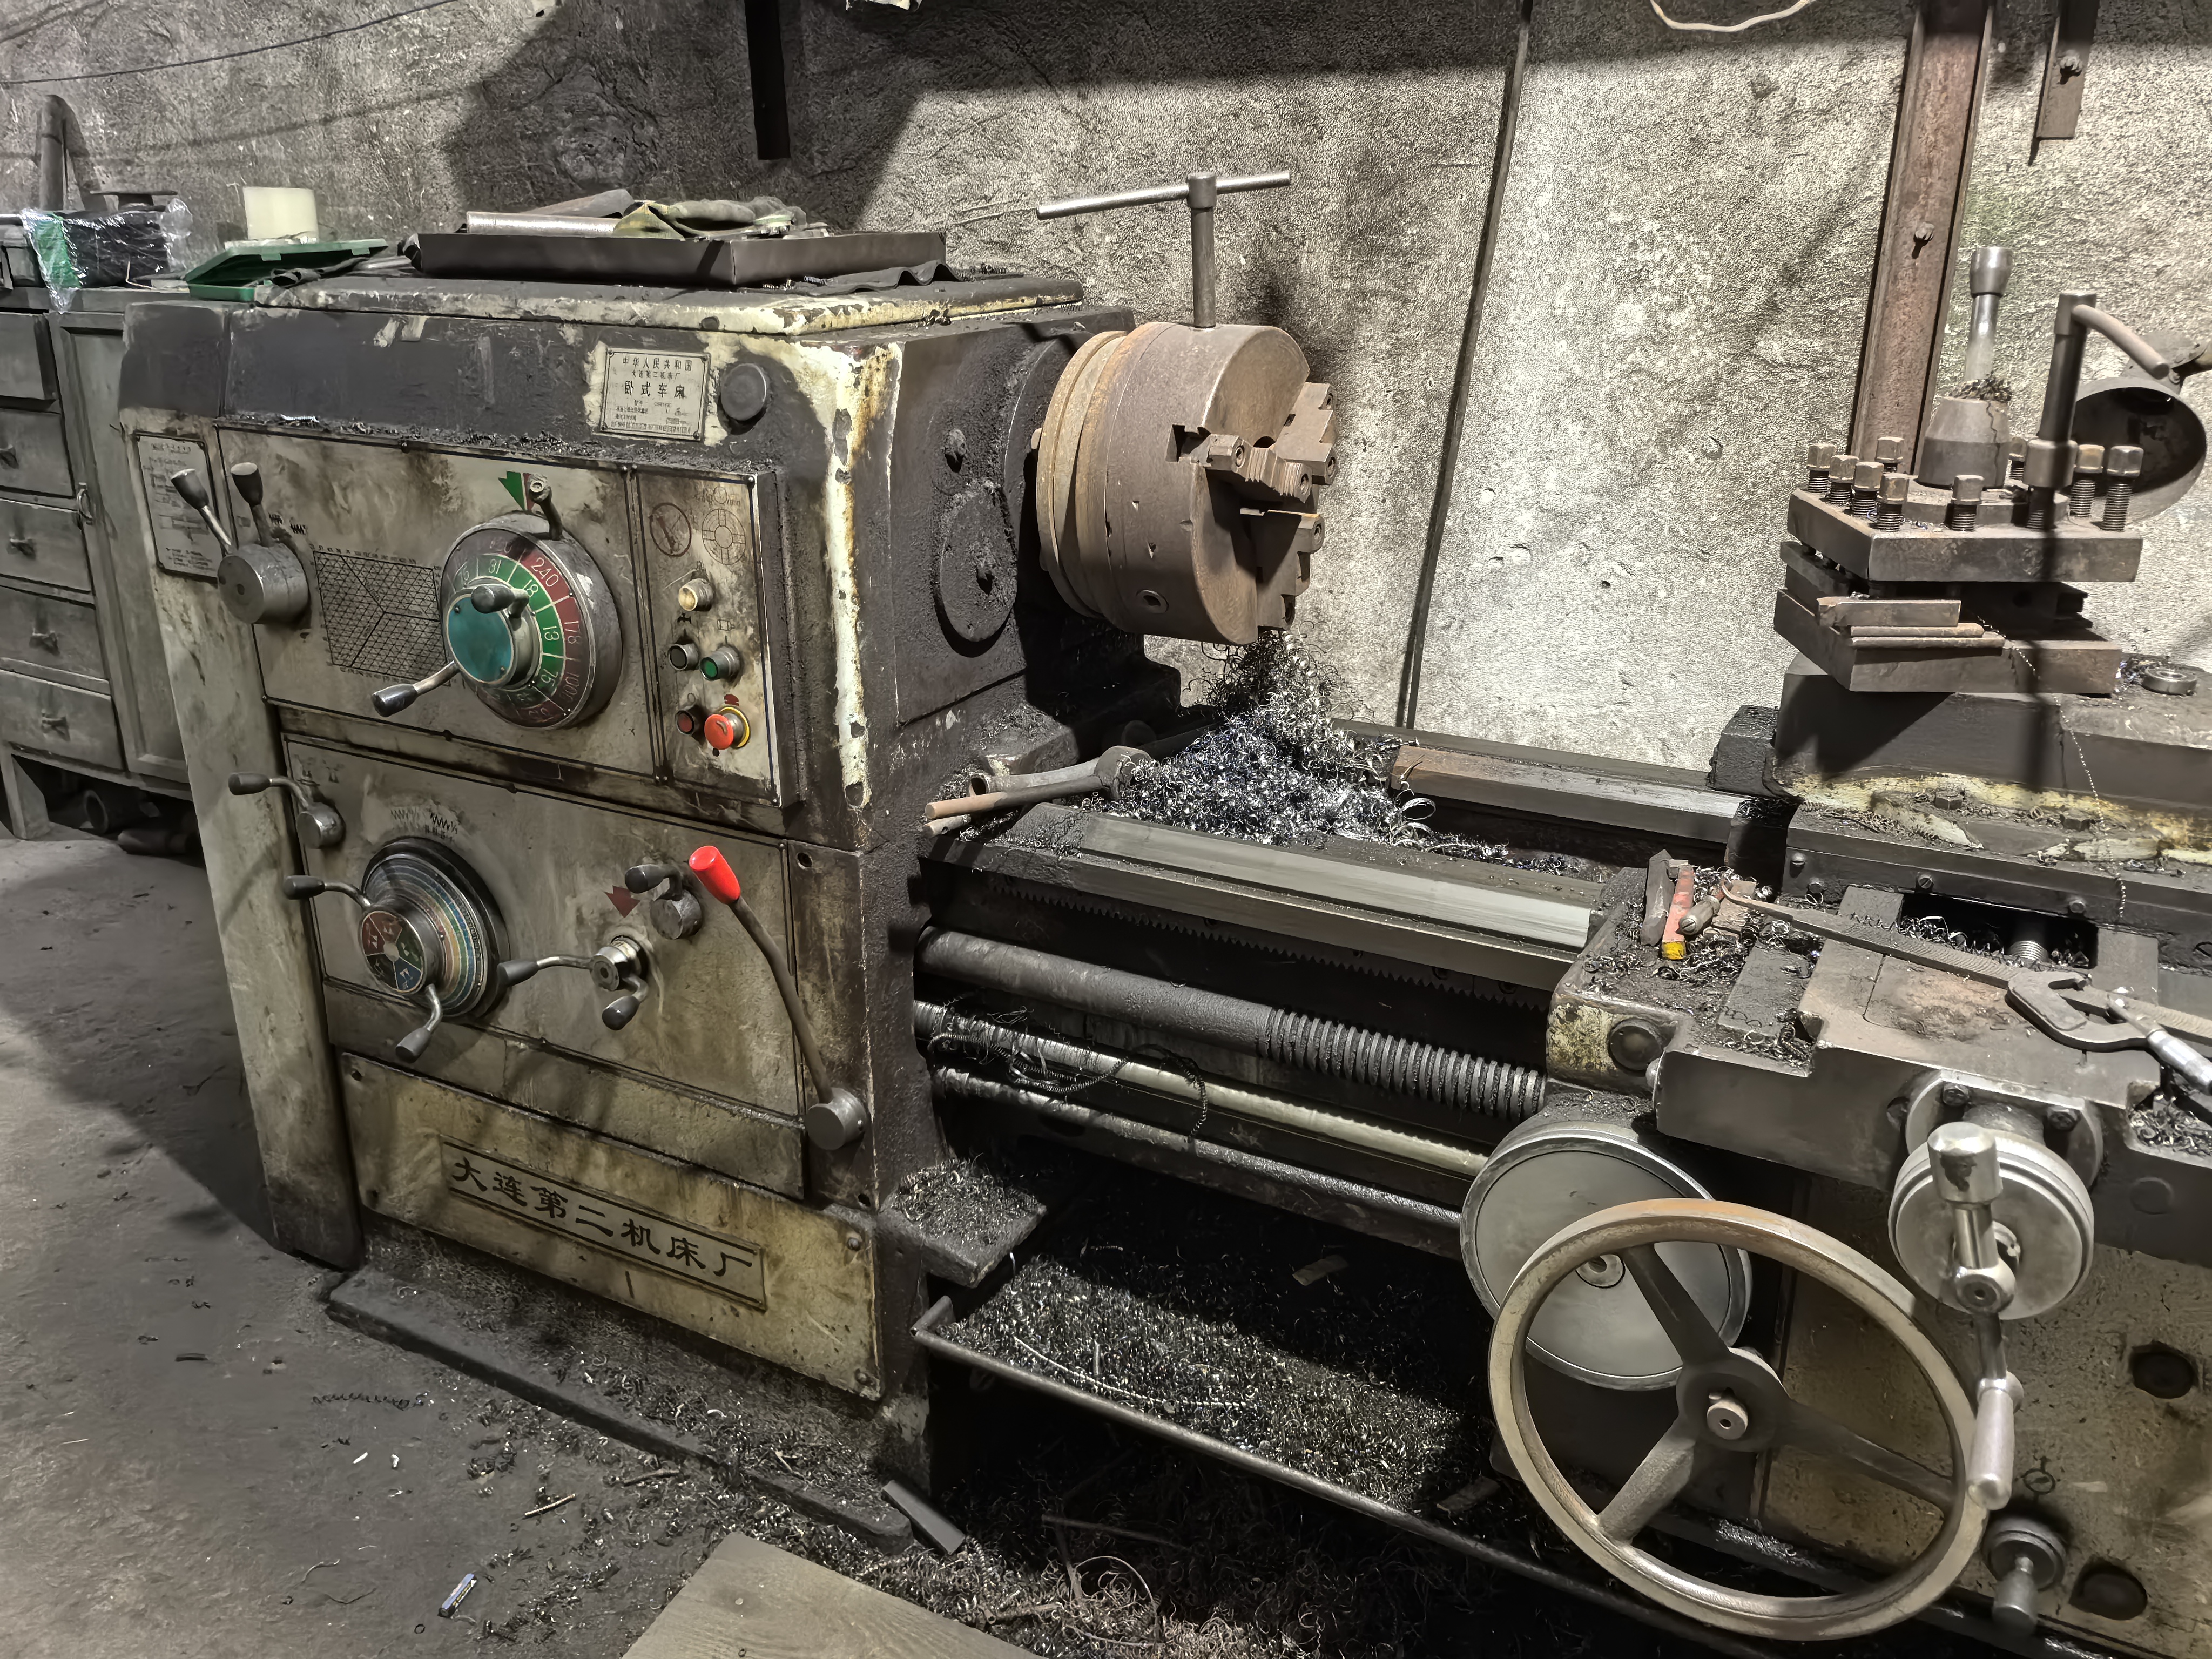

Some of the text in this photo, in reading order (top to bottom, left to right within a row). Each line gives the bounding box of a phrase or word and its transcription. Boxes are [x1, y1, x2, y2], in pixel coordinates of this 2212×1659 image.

[623, 356, 692, 372] 中华人民共和国
[625, 381, 685, 399] 卧式车床
[531, 558, 559, 588] 240
[525, 578, 539, 597] 18
[542, 625, 559, 642] 13
[564, 621, 581, 644] 178
[452, 1156, 753, 1278] 大连第二机床厂
